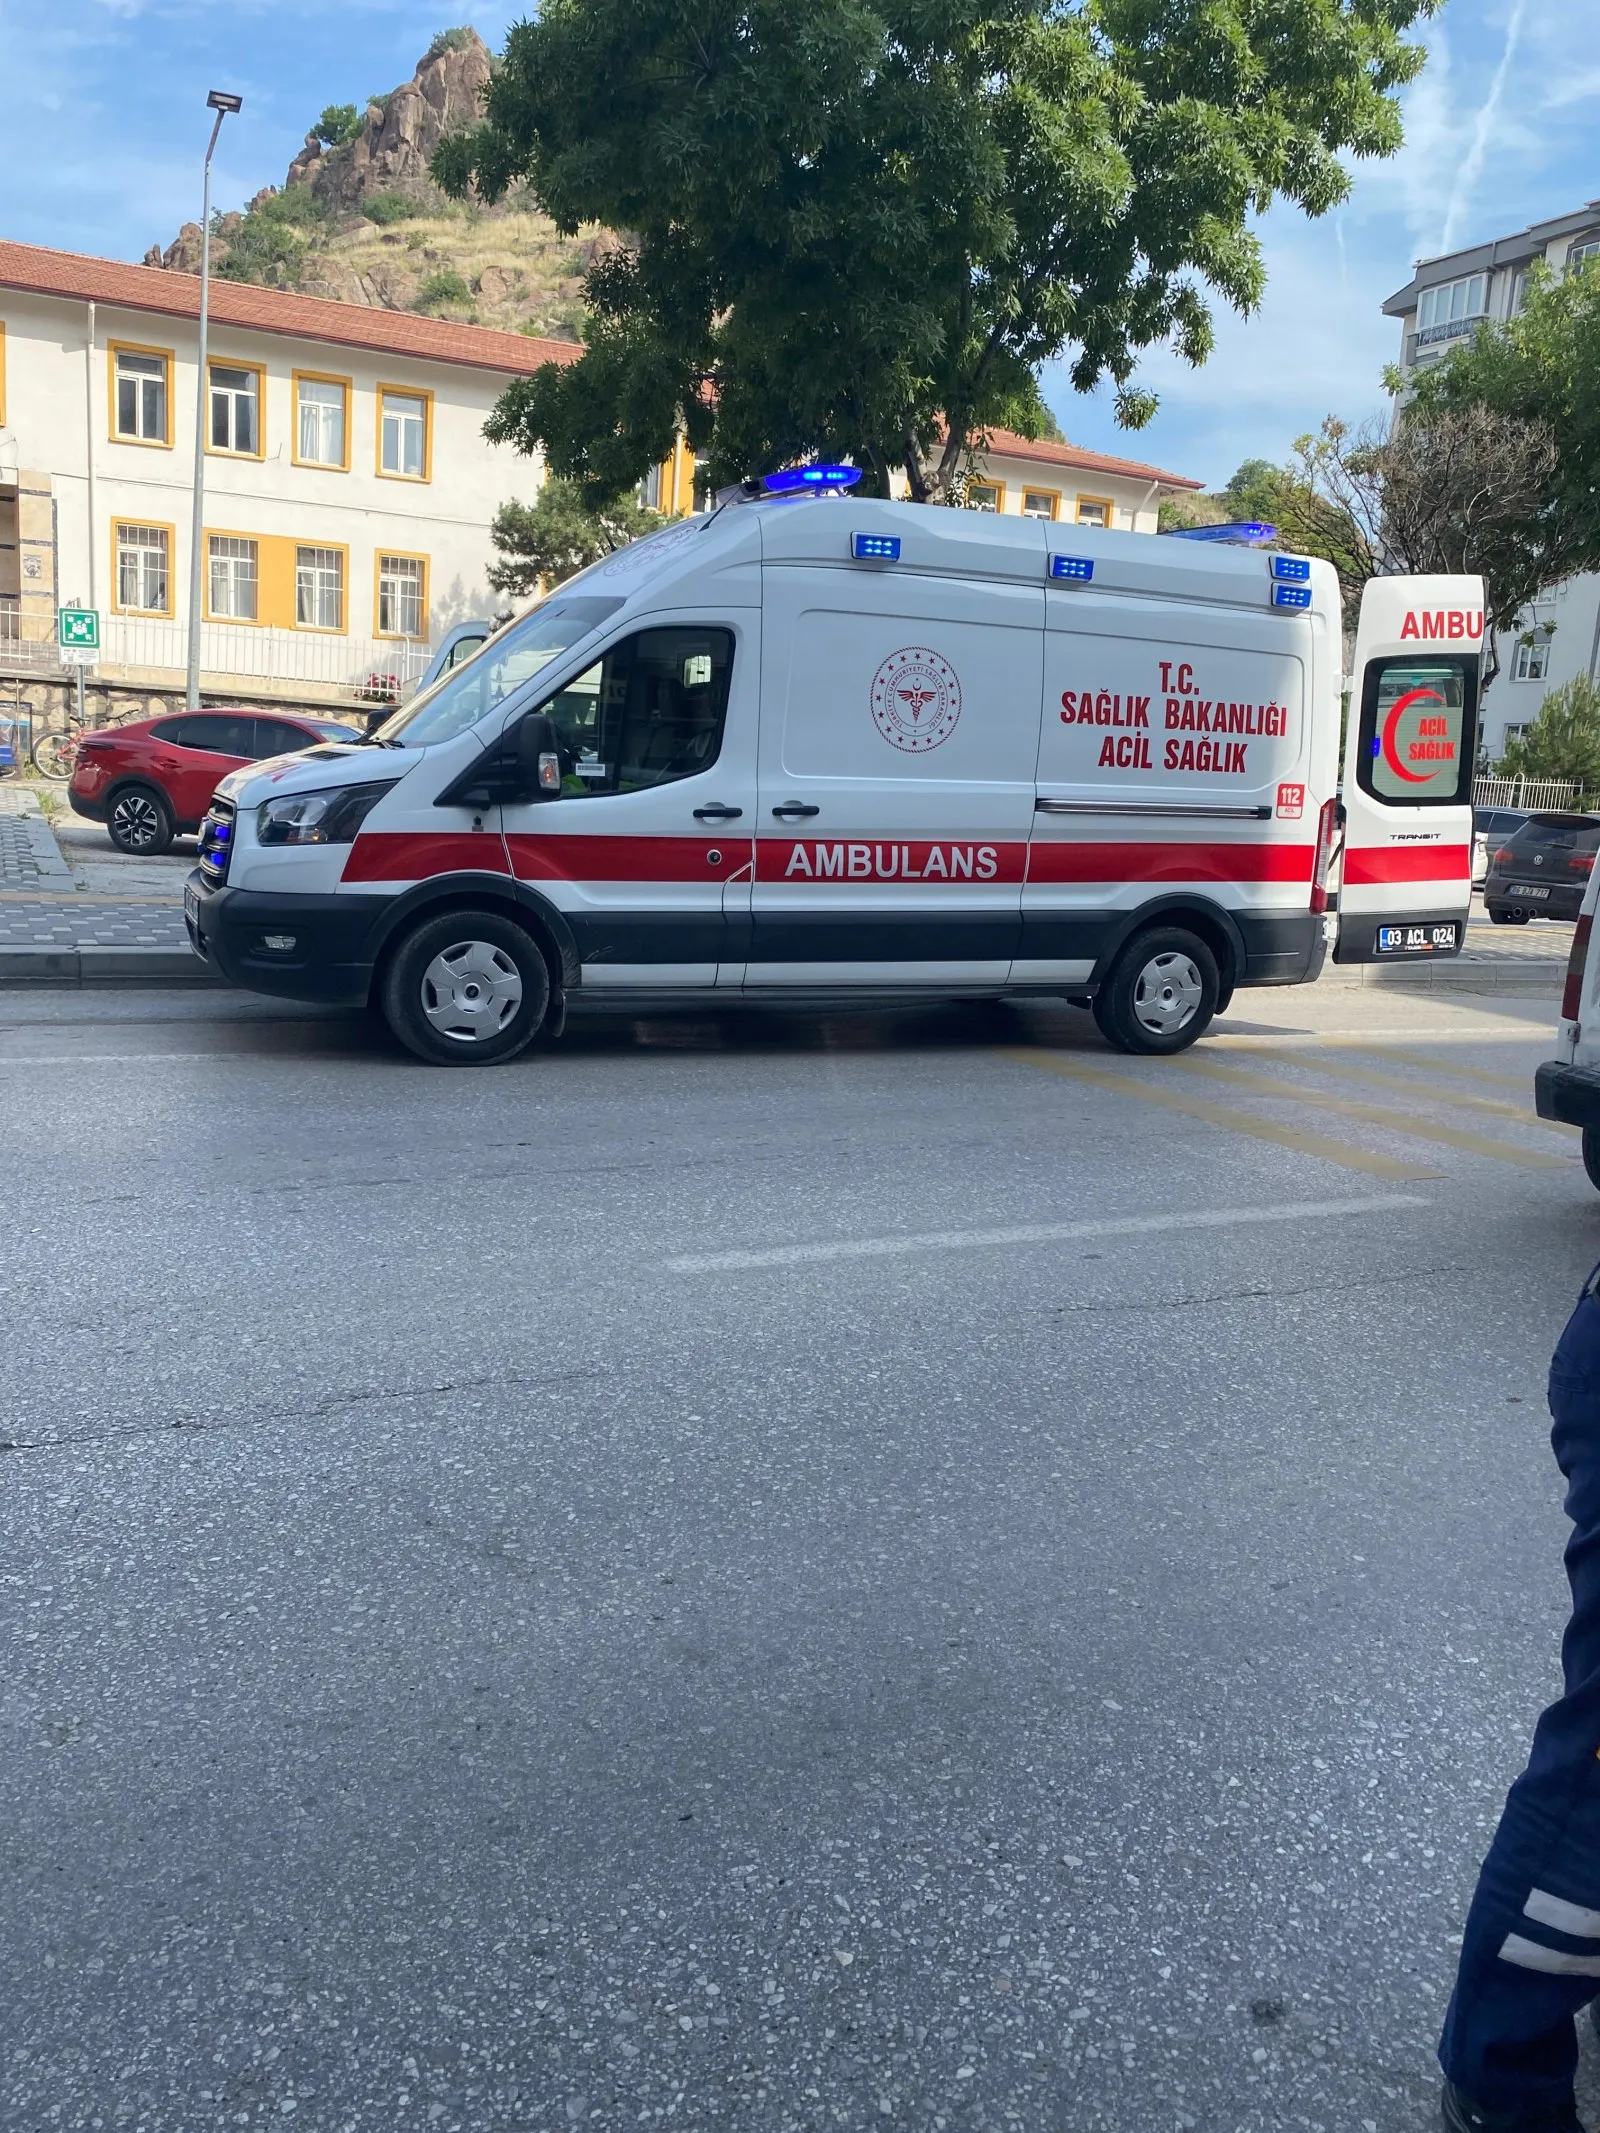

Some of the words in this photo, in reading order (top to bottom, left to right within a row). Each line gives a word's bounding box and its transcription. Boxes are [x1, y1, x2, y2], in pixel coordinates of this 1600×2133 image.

[1400, 611, 1483, 640] AMBU
[1158, 661, 1200, 695] T.C.
[1060, 688, 1151, 728] SAĞLIK
[1164, 699, 1288, 737] BAKANLIĞI
[1418, 715, 1448, 736] ACİL
[1098, 731, 1153, 769] ACİL
[1163, 735, 1249, 773] SAĞLIK
[1408, 739, 1456, 761] SAĞLIK
[1281, 787, 1301, 804] 112
[784, 843, 998, 878] AMBULANS
[1387, 930, 1402, 946] 03
[1406, 929, 1428, 945] ACL
[1432, 927, 1453, 943] 024
